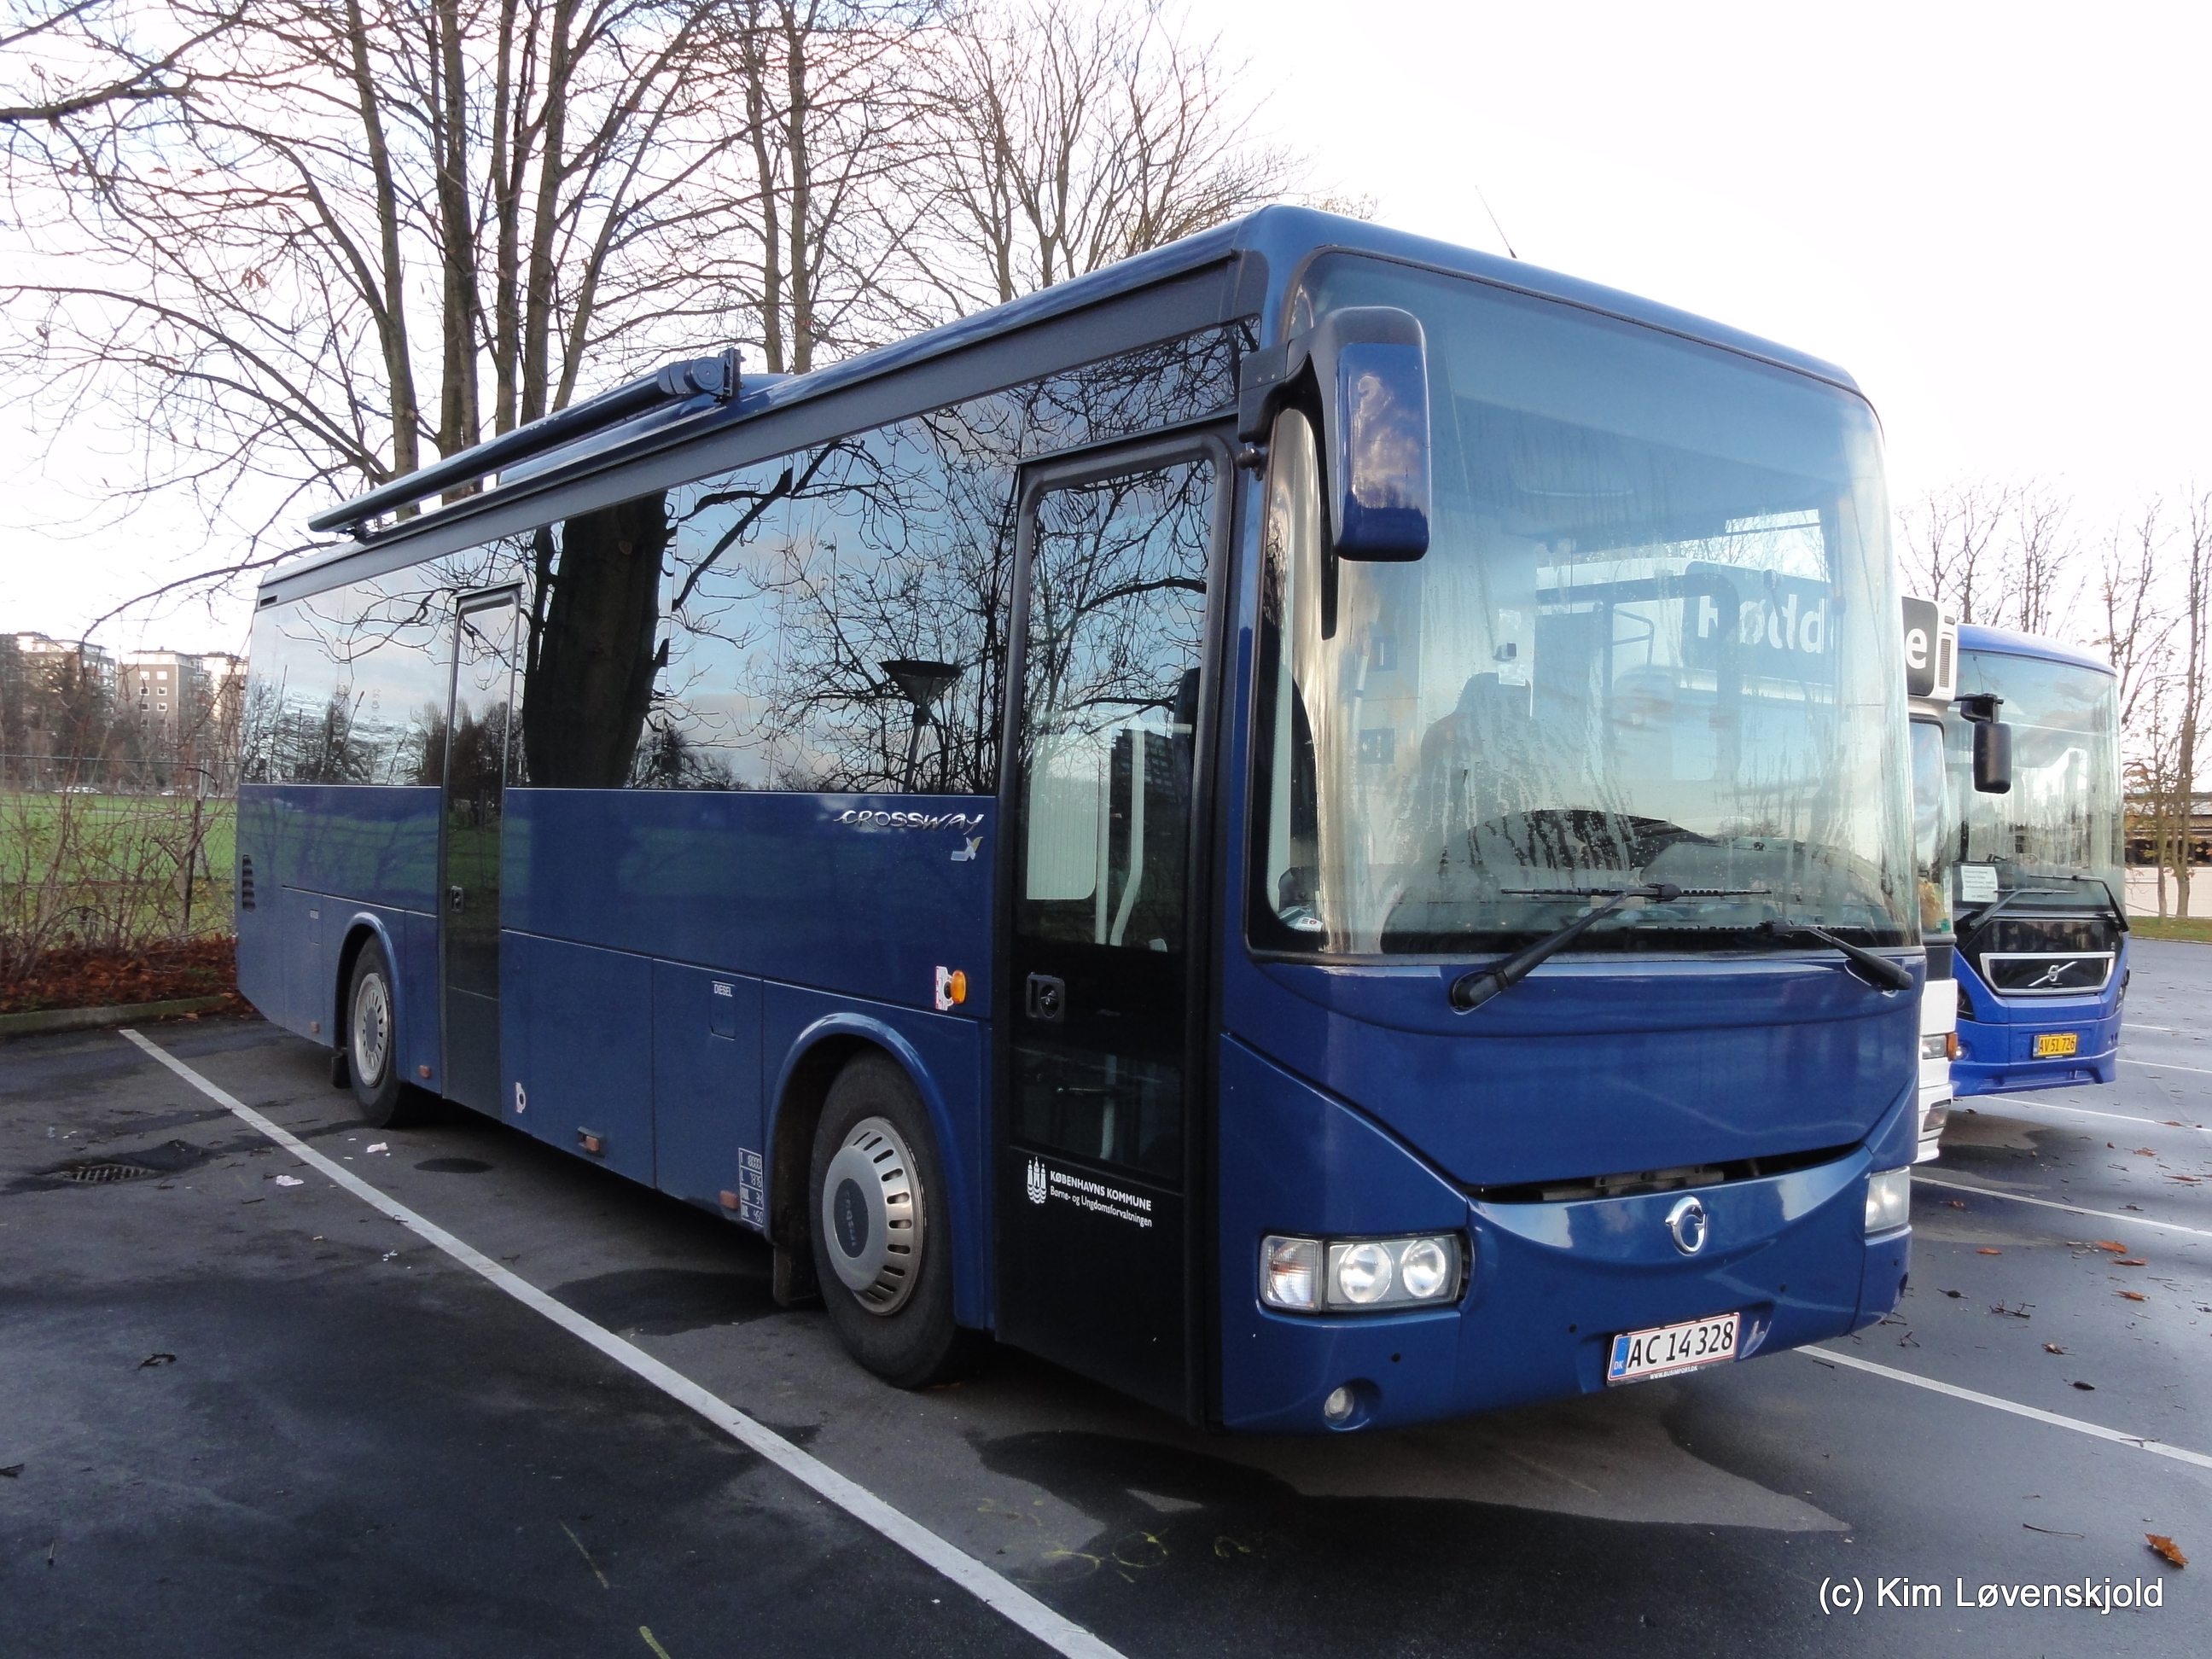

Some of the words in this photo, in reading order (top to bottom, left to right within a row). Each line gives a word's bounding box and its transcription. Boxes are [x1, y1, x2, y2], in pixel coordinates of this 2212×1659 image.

[833, 810, 984, 835] CROSSWAY
[713, 984, 733, 998] DIESEL
[1050, 1170, 1105, 1196] KØBENHAVNS
[1107, 1188, 1152, 1211] KOMMUNE
[1072, 1196, 1080, 1206] og
[1081, 1196, 1152, 1228] Ungdomsforvaltningen
[1614, 1360, 1623, 1371] DK
[1627, 1335, 1661, 1369] AC
